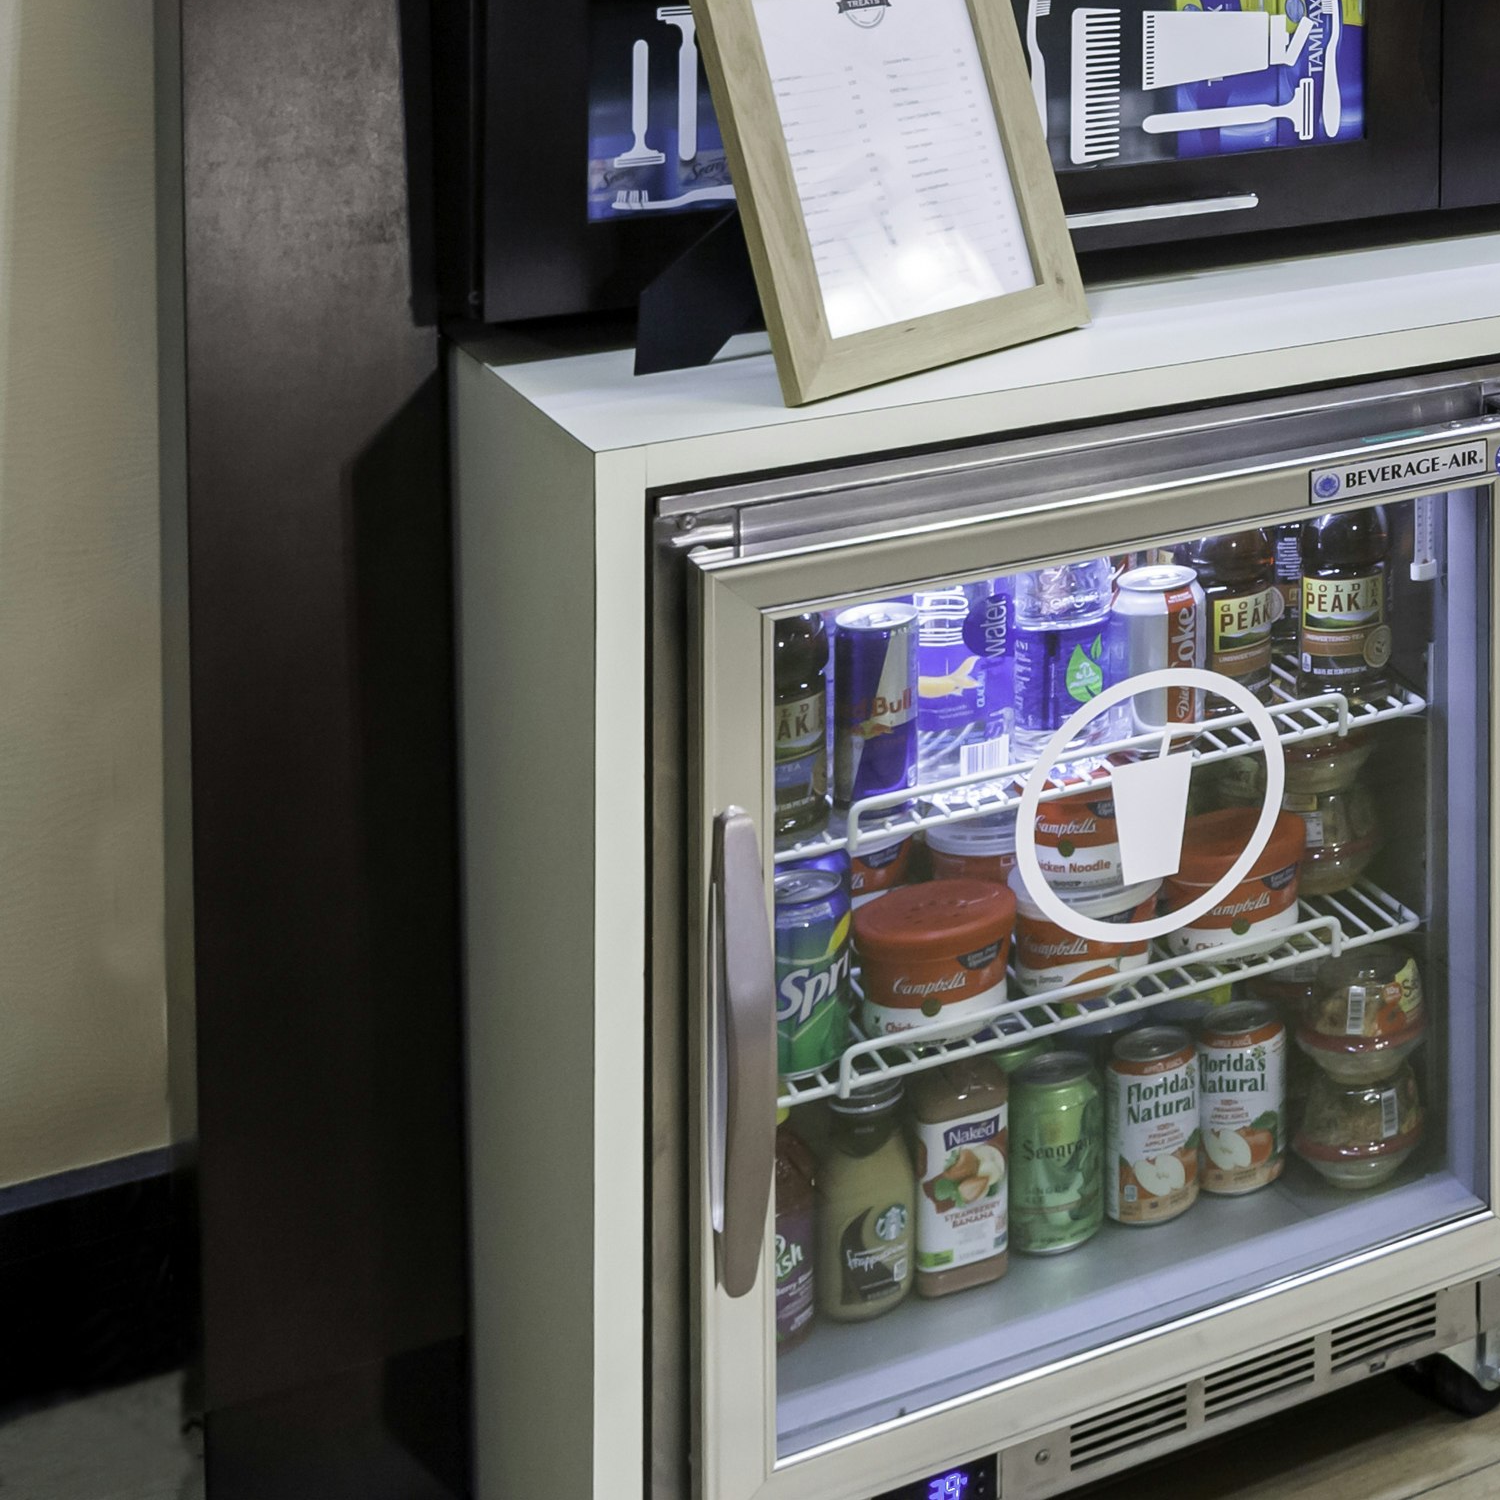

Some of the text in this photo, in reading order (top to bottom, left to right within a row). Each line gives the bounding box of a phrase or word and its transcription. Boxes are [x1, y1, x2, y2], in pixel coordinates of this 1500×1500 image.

[1346, 450, 1478, 488] BEVERAGE-AIR
[1306, 583, 1360, 593] GOLD
[1306, 592, 1360, 612] PEAK
[984, 596, 1007, 659] water
[872, 688, 912, 718] Bull
[1069, 860, 1111, 873] Noodle
[893, 972, 967, 997] Campbell's
[1127, 1073, 1196, 1105] Florida's
[1127, 1090, 1195, 1126] Natural
[950, 1121, 995, 1146] Naked
[953, 1211, 994, 1229] BANANA
